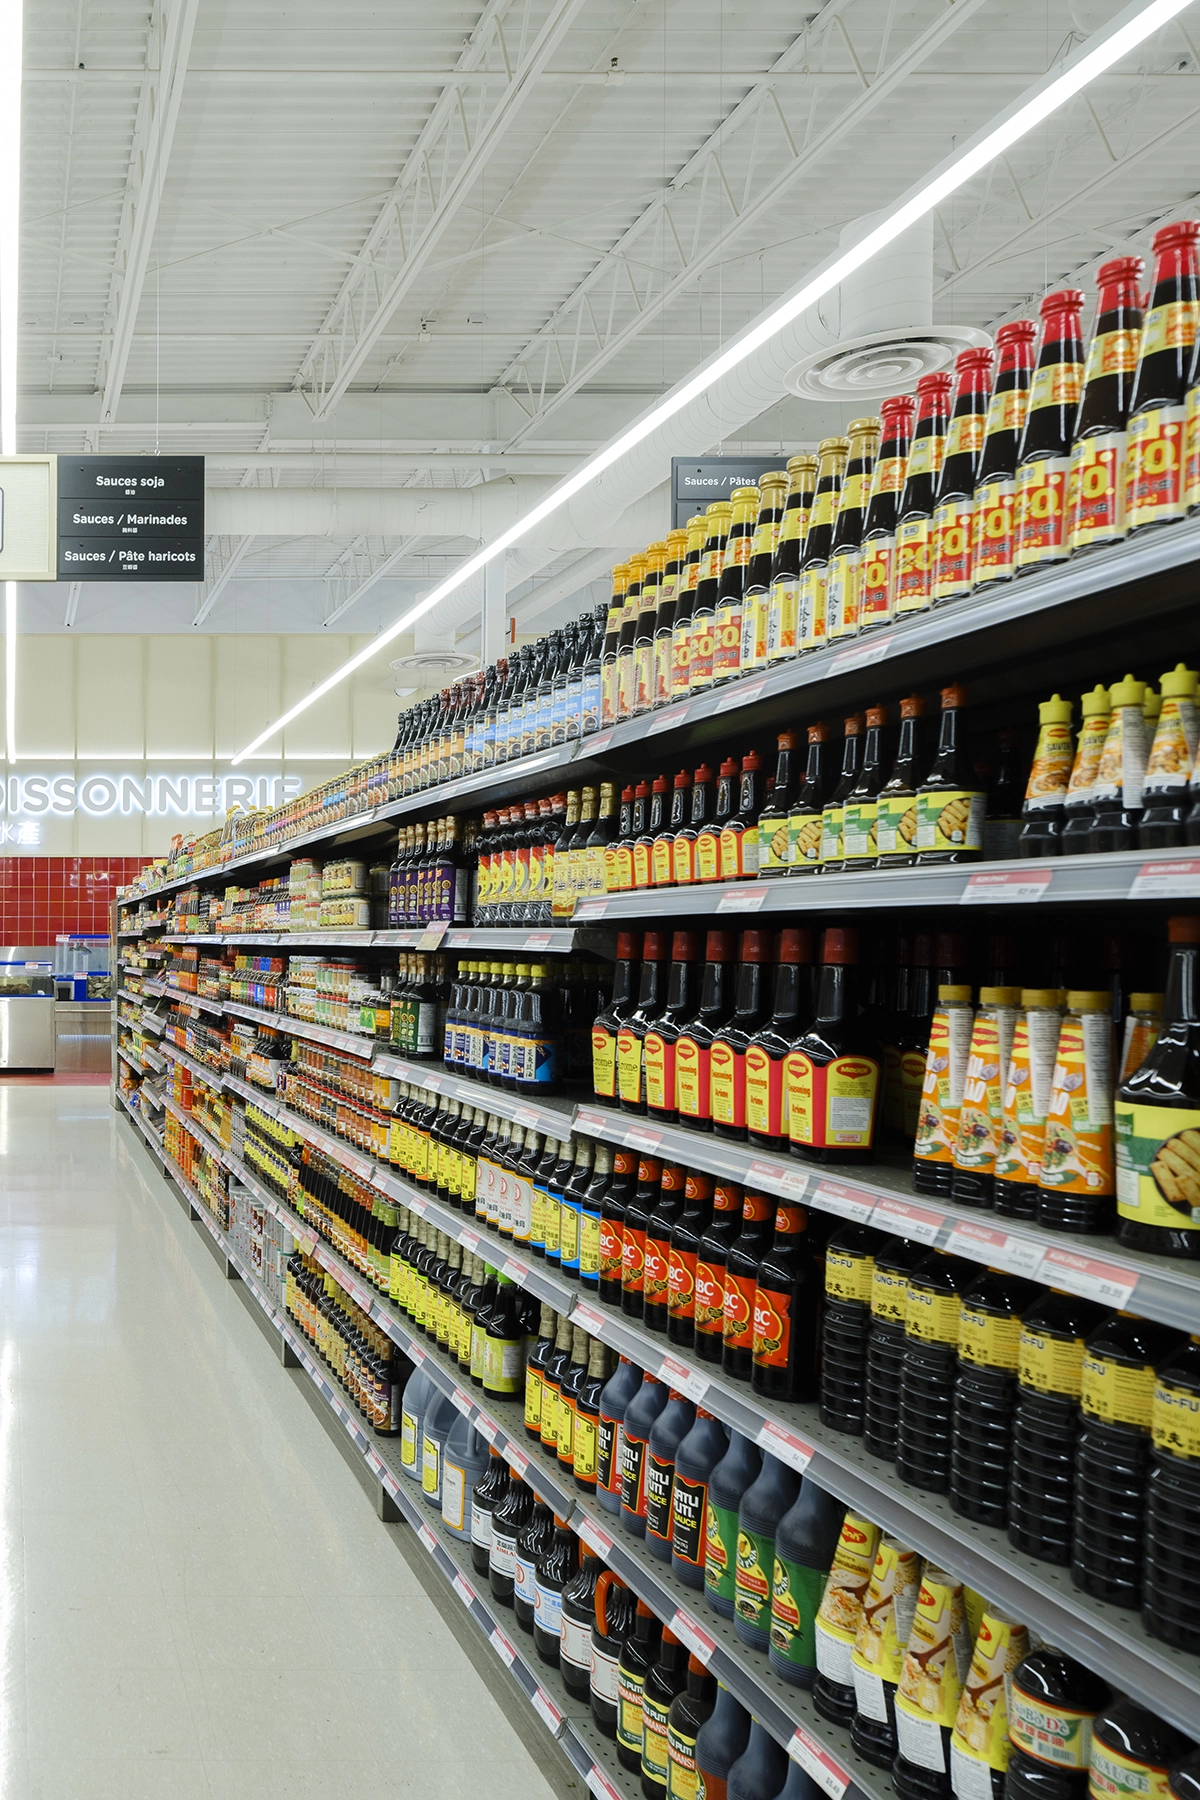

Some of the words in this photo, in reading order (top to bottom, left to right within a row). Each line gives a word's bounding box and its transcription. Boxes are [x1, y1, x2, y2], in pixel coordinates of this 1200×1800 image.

[96, 475, 138, 487] Sauces
[140, 475, 165, 489] soja
[684, 477, 719, 486] Sauces
[721, 476, 727, 486] /
[729, 476, 756, 486] Pâtes
[72, 513, 114, 525] Sauces
[117, 513, 124, 526] /
[127, 513, 188, 525] Marinades
[64, 550, 106, 562] Sauces
[108, 550, 116, 563] /
[118, 549, 145, 562] Pâte
[147, 549, 196, 562] haricots
[496, 1546, 516, 1557] KIMLA
